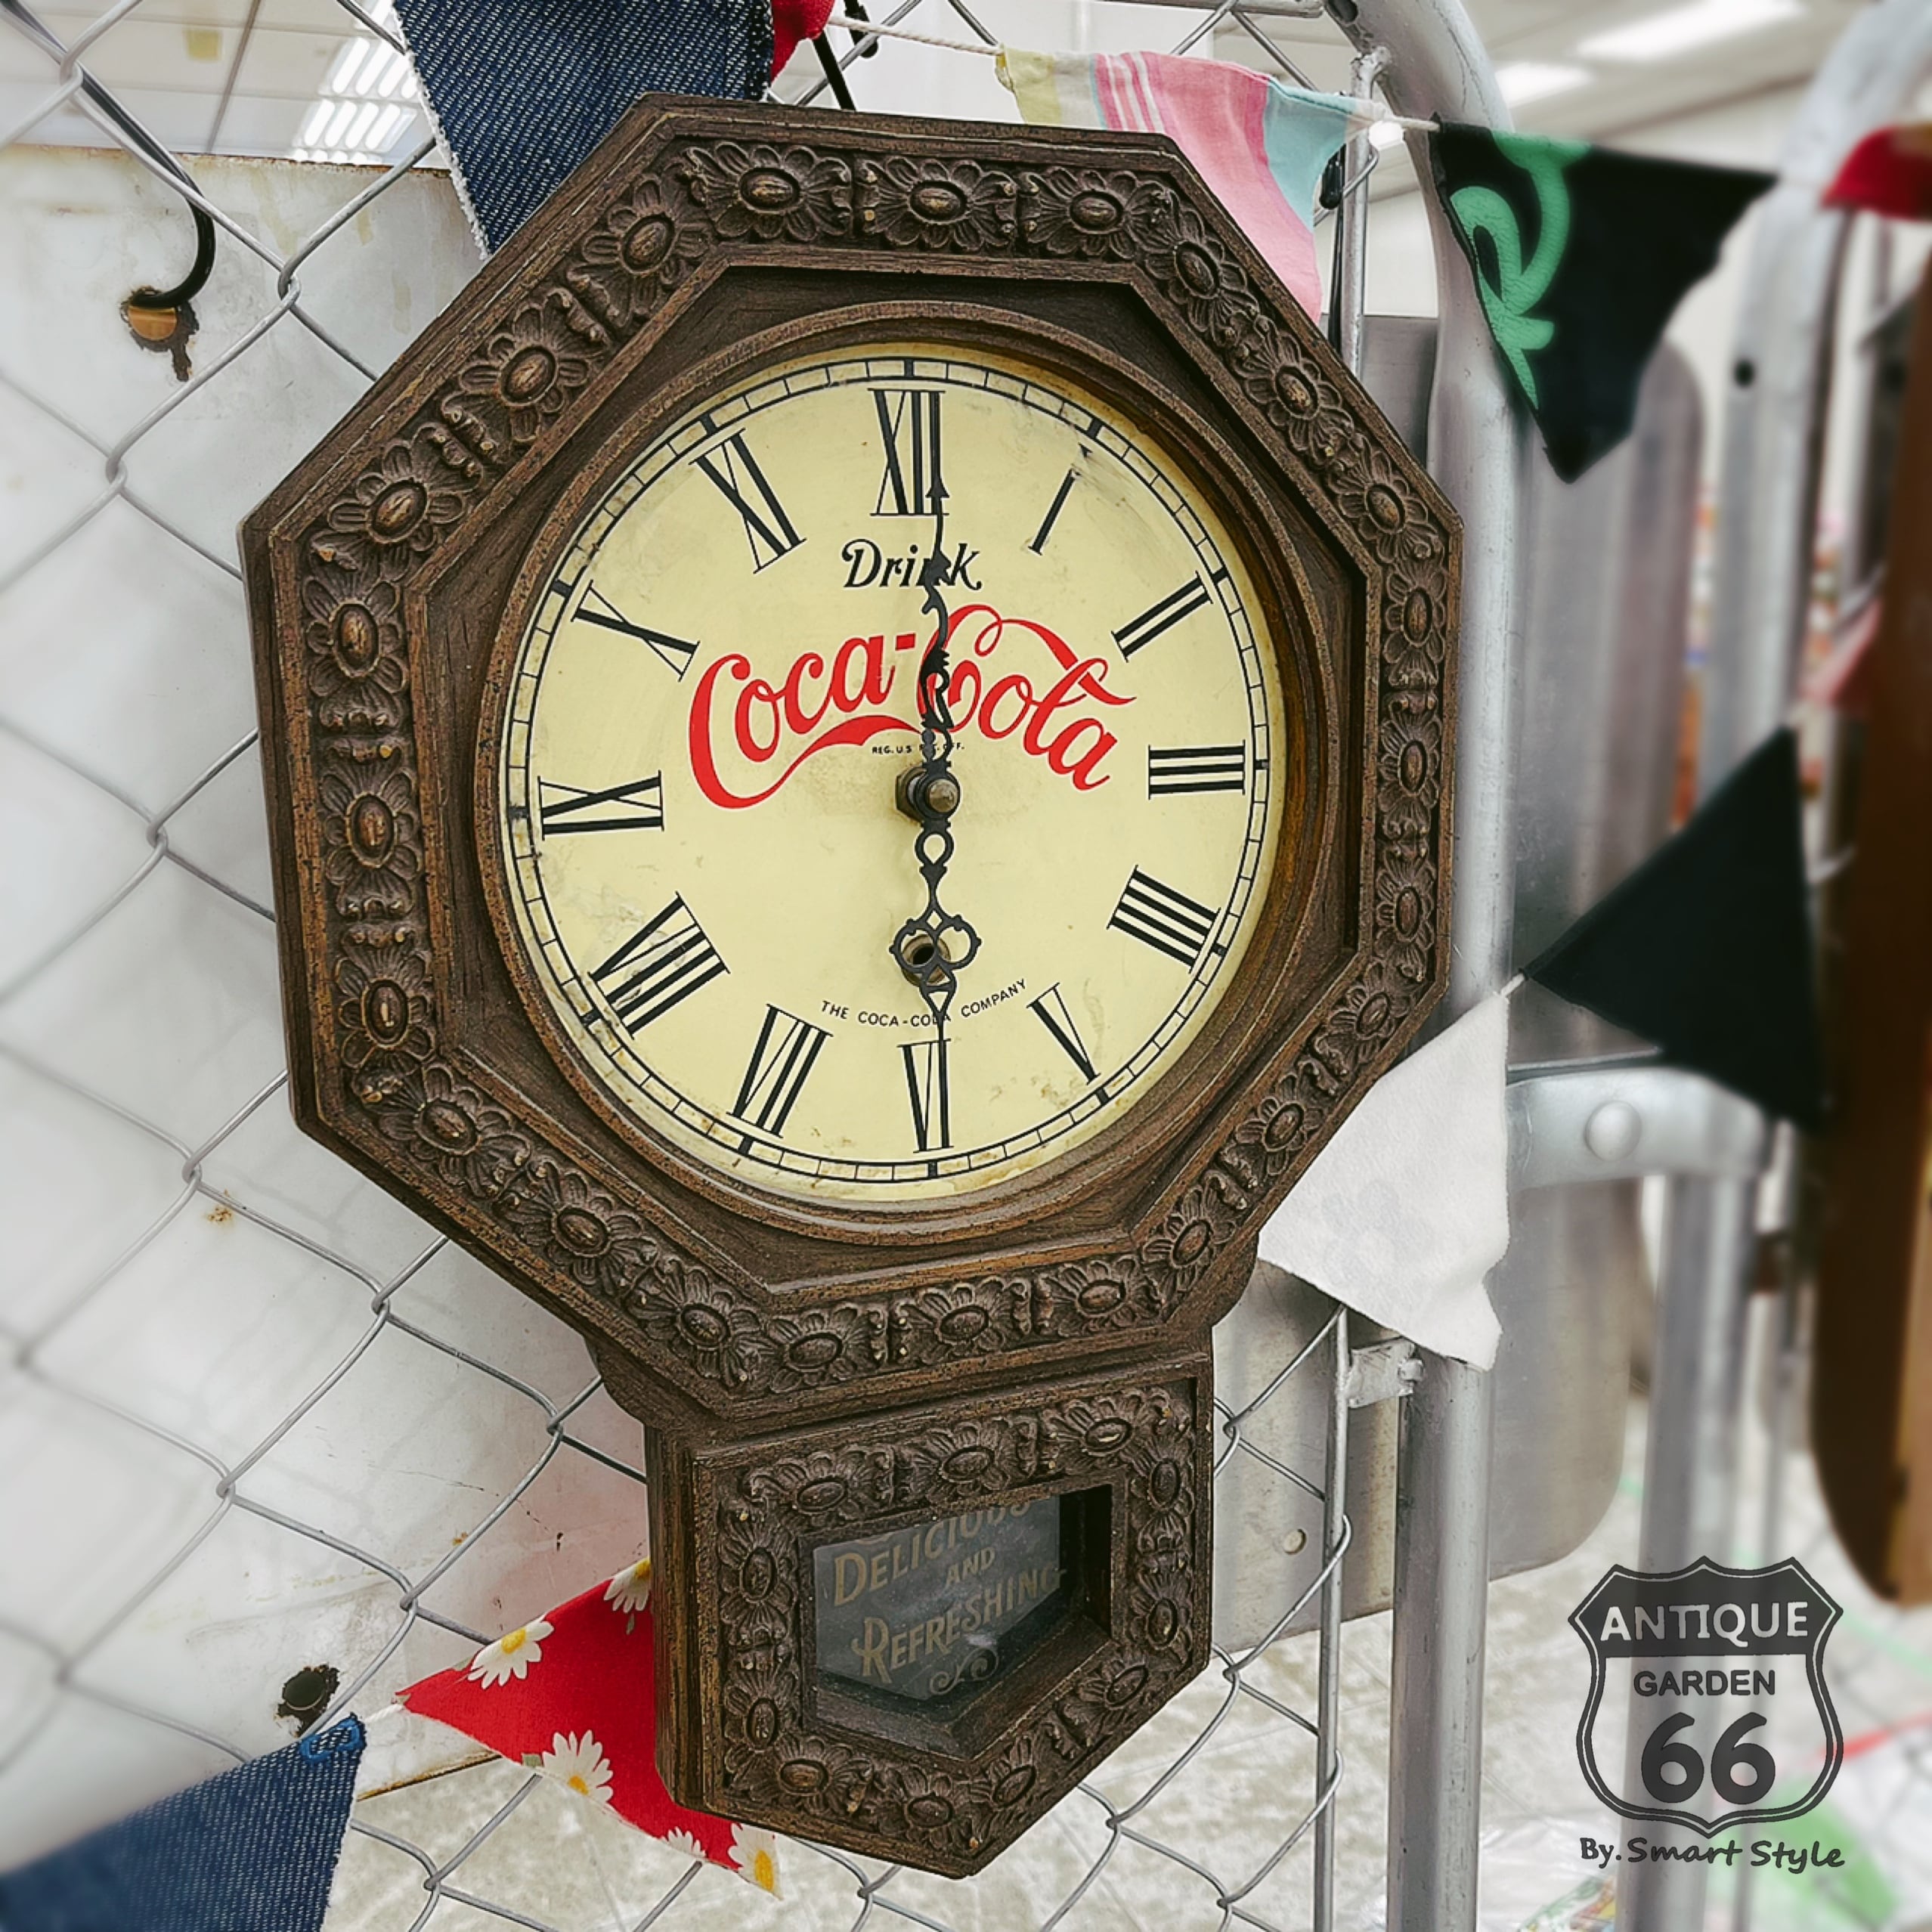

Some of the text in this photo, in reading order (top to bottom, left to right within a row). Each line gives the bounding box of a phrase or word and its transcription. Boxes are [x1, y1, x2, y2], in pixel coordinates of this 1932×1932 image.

[571, 579, 701, 682] X
[689, 604, 1137, 809] Coca-Cola
[822, 1000, 850, 1019] THE
[961, 978, 1026, 1018] COMPANY
[945, 1546, 995, 1587] AND
